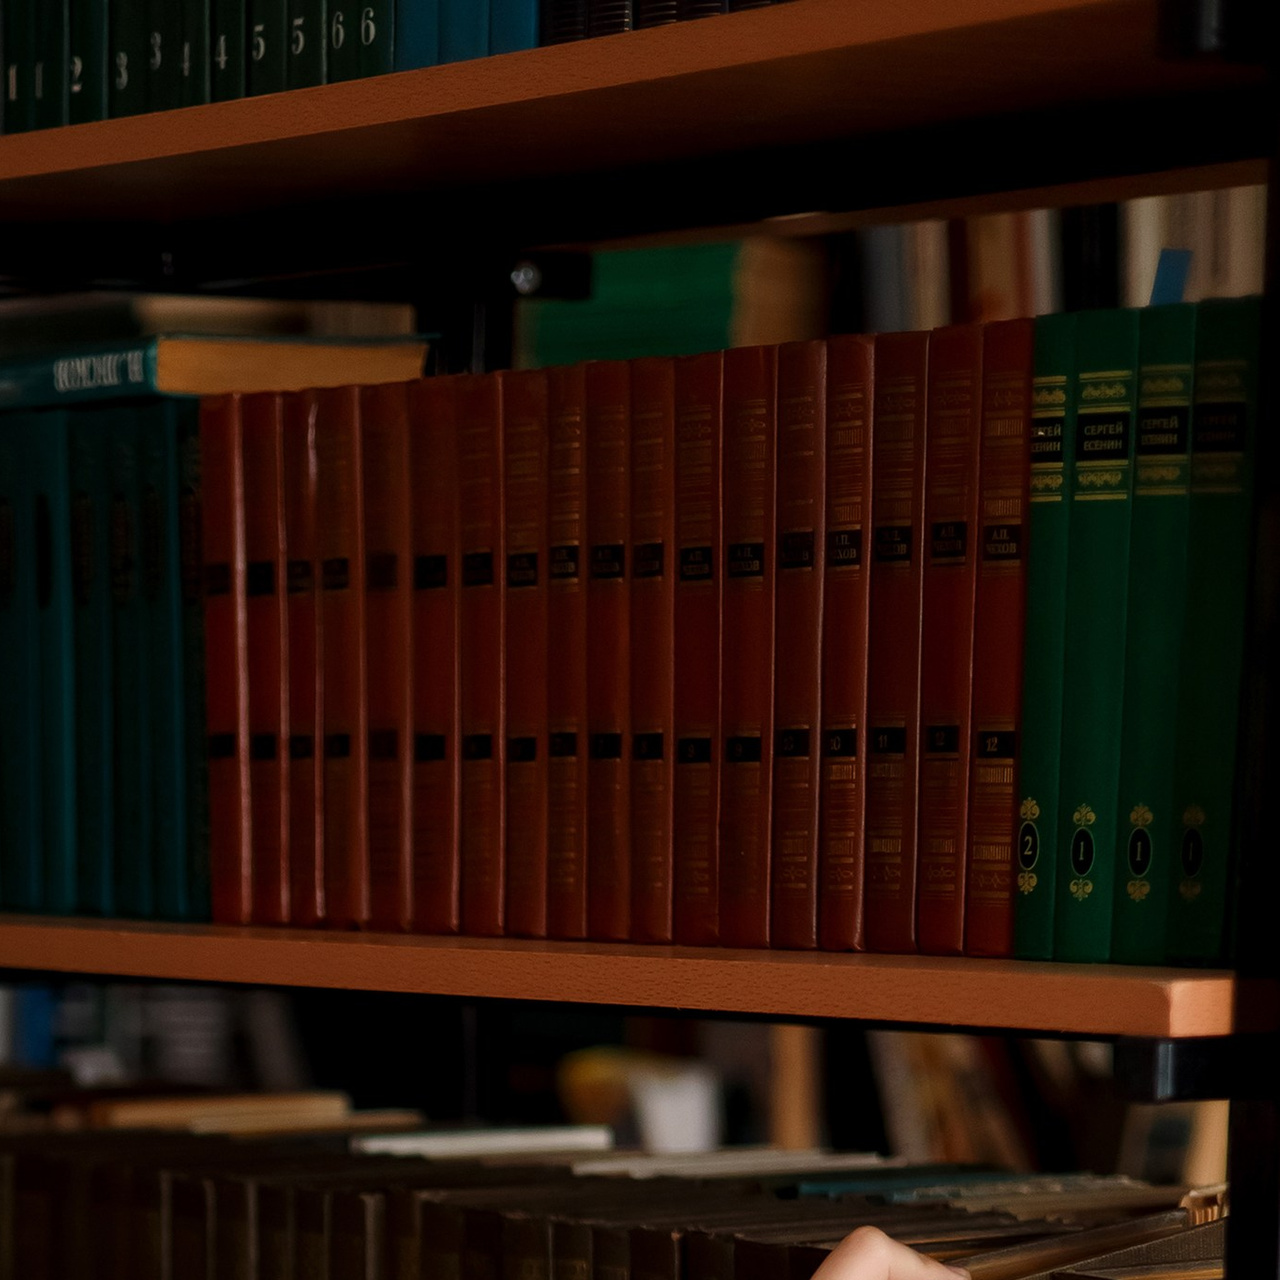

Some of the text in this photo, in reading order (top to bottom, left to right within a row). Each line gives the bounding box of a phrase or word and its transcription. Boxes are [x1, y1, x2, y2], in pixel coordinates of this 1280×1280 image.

[291, 16, 305, 55] 5
[332, 11, 345, 49] 6
[360, 7, 376, 46] 6
[150, 31, 162, 70] 3
[214, 34, 228, 70] 4
[252, 24, 265, 61] 5
[70, 55, 83, 94] 2
[115, 51, 128, 90] 3
[1083, 421, 1124, 436] СЕРГЕЙ
[1141, 415, 1179, 430] СЕРГЕЙ
[1031, 440, 1061, 453] СЕНИН
[1083, 439, 1123, 452] ЕСЕНИН
[1140, 433, 1178, 446] ЕСЕНИН
[877, 733, 889, 750] 11
[985, 735, 999, 752] 12
[1022, 835, 1033, 856] 2
[1135, 840, 1142, 862] 1
